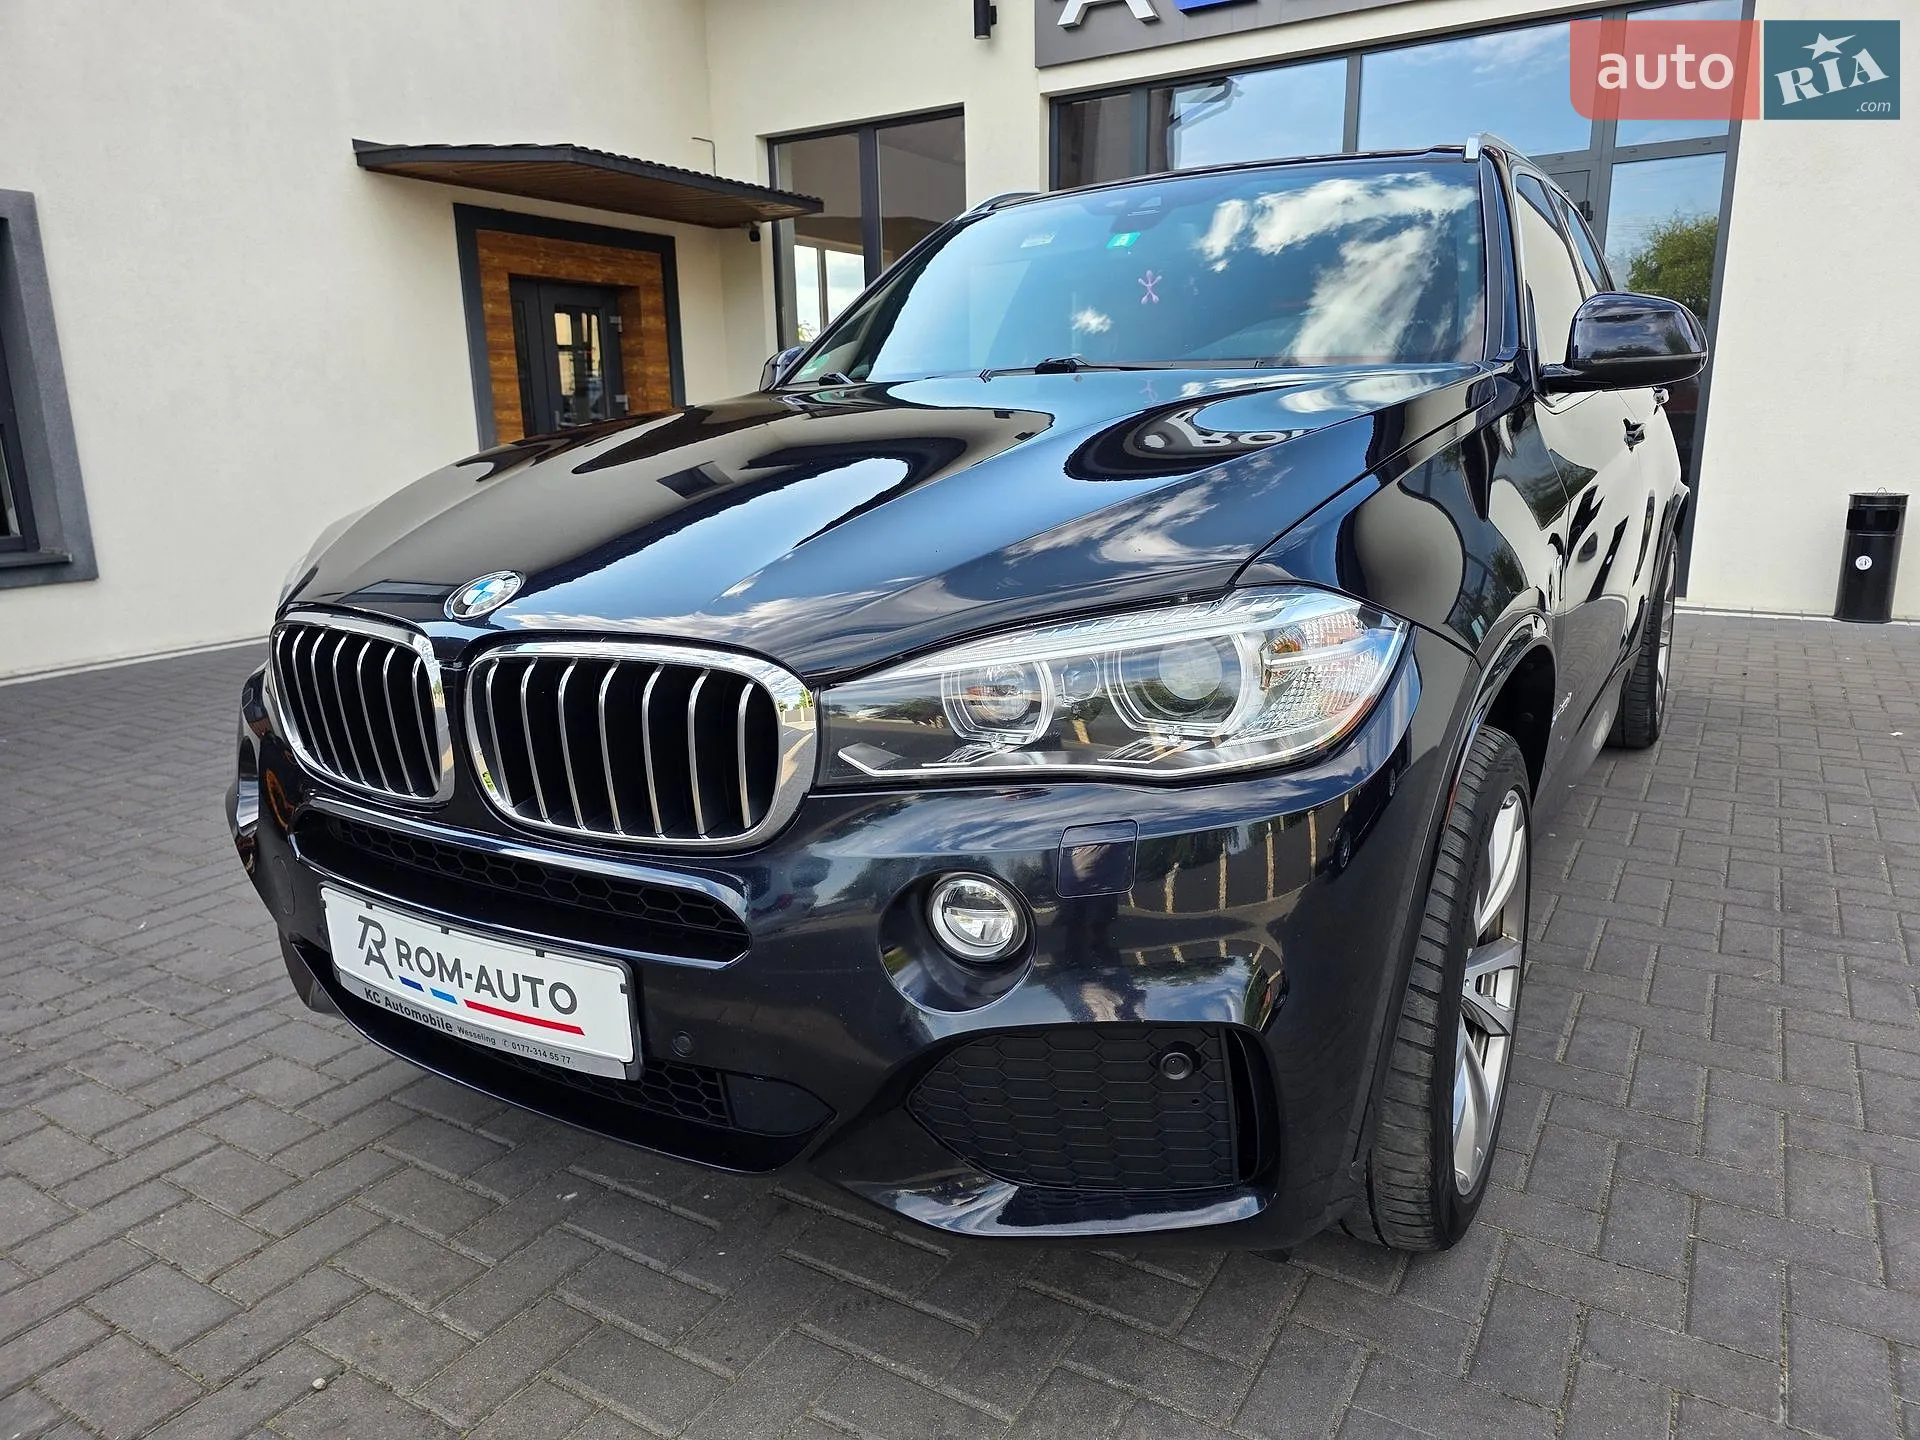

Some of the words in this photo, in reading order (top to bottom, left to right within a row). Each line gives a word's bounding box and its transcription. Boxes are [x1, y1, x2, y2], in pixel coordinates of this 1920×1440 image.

[394, 936, 578, 1015] ROM-AUTO
[364, 987, 381, 1004] KC
[384, 996, 453, 1033] Automobile
[457, 1025, 496, 1046] Wesseling
[511, 1041, 548, 1058] 0177-314
[561, 1055, 571, 1064] 77
